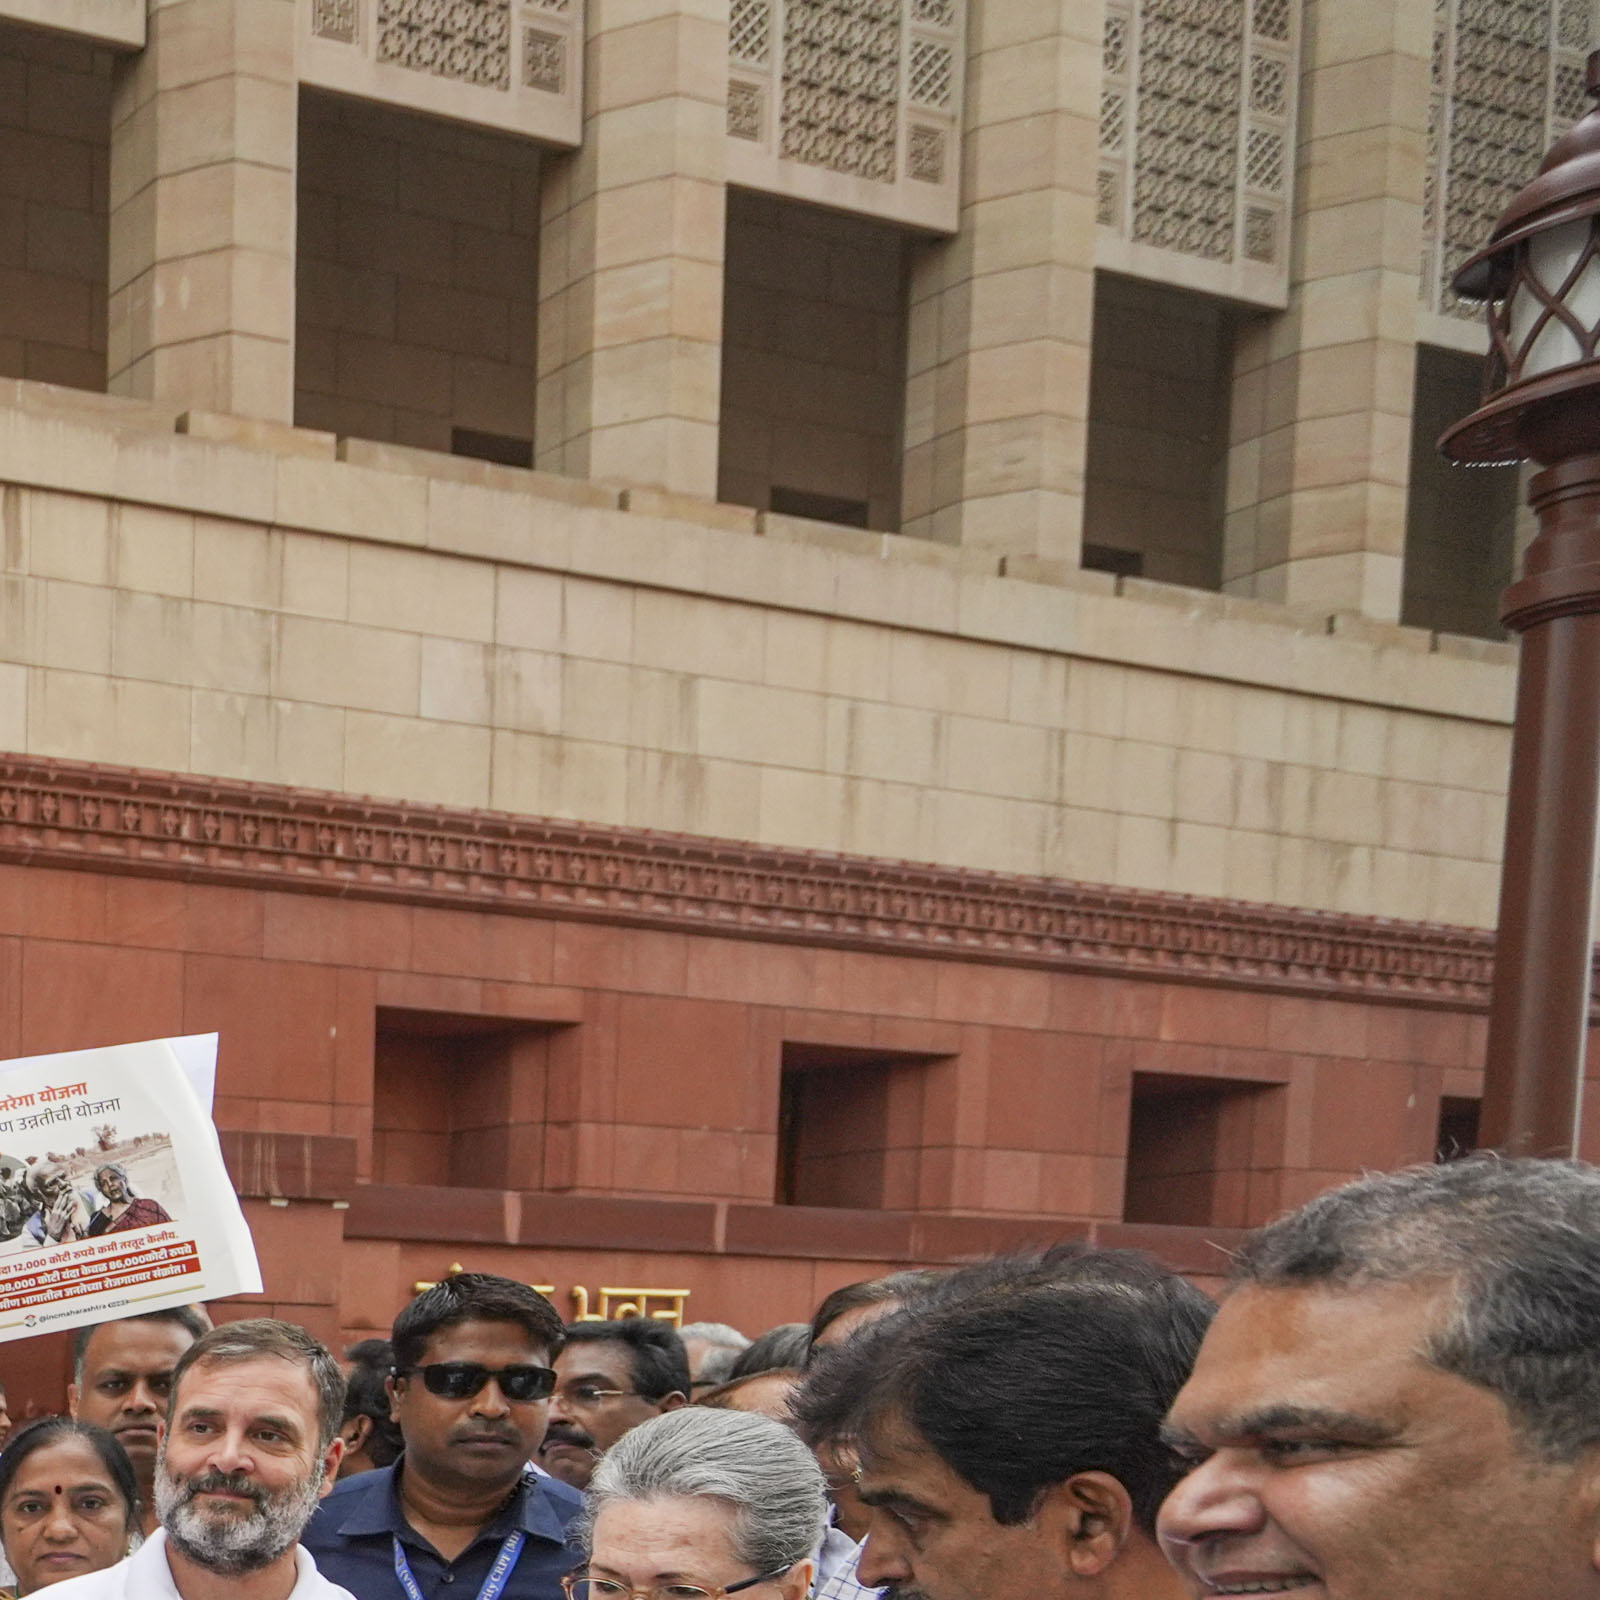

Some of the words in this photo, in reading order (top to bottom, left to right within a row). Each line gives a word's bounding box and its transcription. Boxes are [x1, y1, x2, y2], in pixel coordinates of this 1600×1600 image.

[37, 1082, 88, 1103] योजना
[74, 1098, 121, 1118] योजना
[13, 1258, 47, 1273] 12,000
